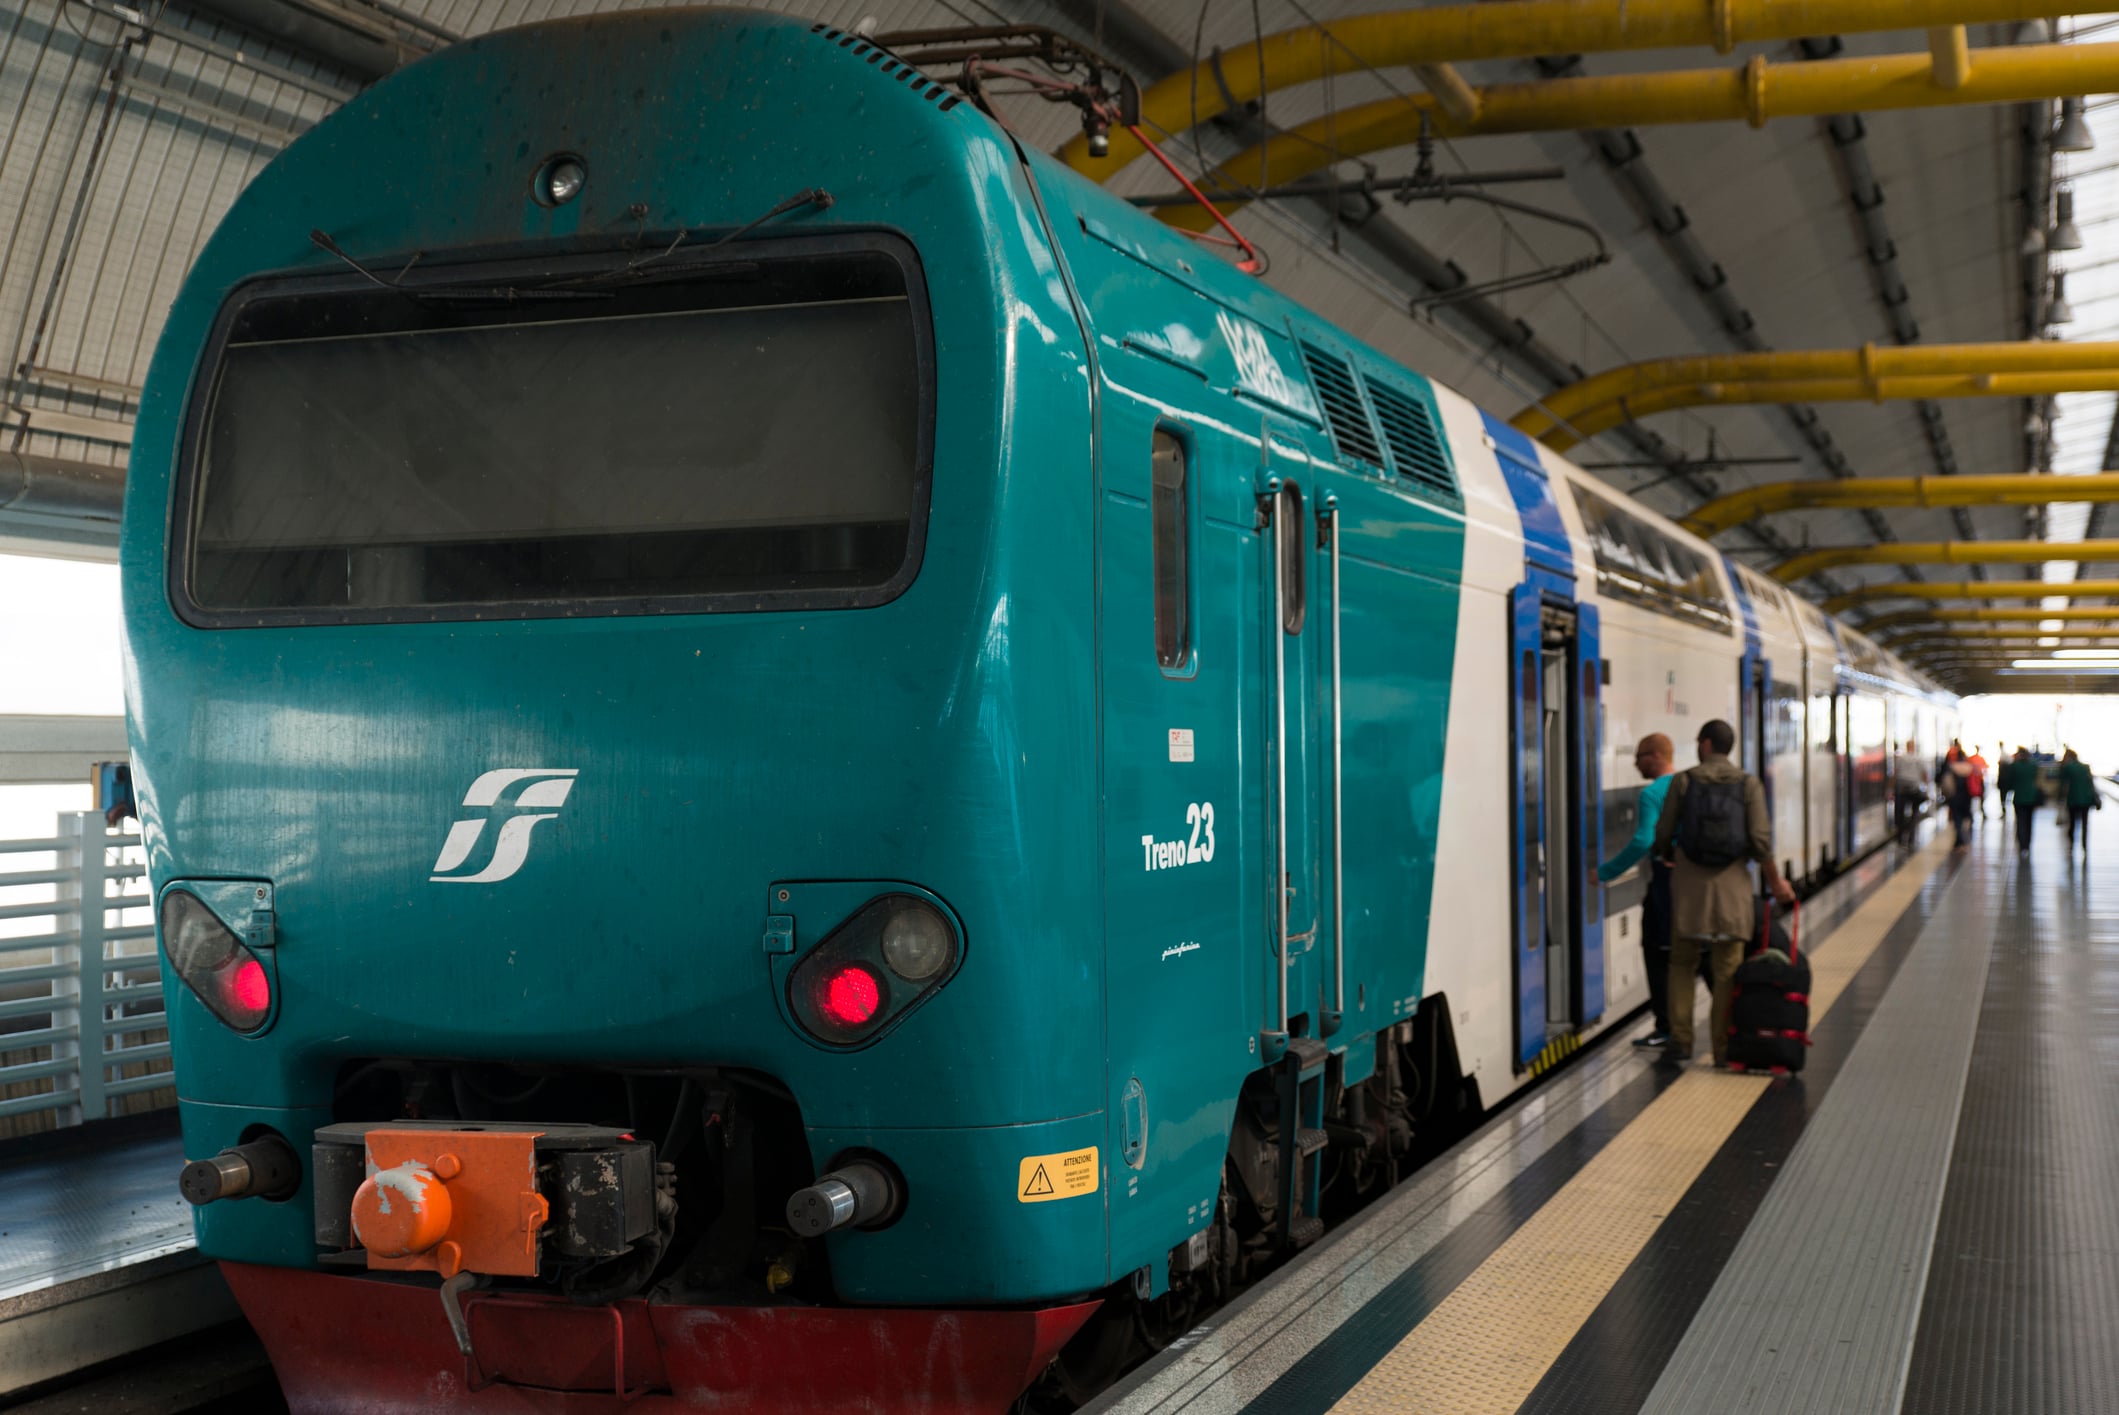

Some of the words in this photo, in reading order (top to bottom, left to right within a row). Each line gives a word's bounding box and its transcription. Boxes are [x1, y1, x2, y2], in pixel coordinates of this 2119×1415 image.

[1141, 834, 1186, 872] Treno
[1186, 802, 1215, 864] 23
[1064, 1154, 1091, 1166] ATTENZIONE
